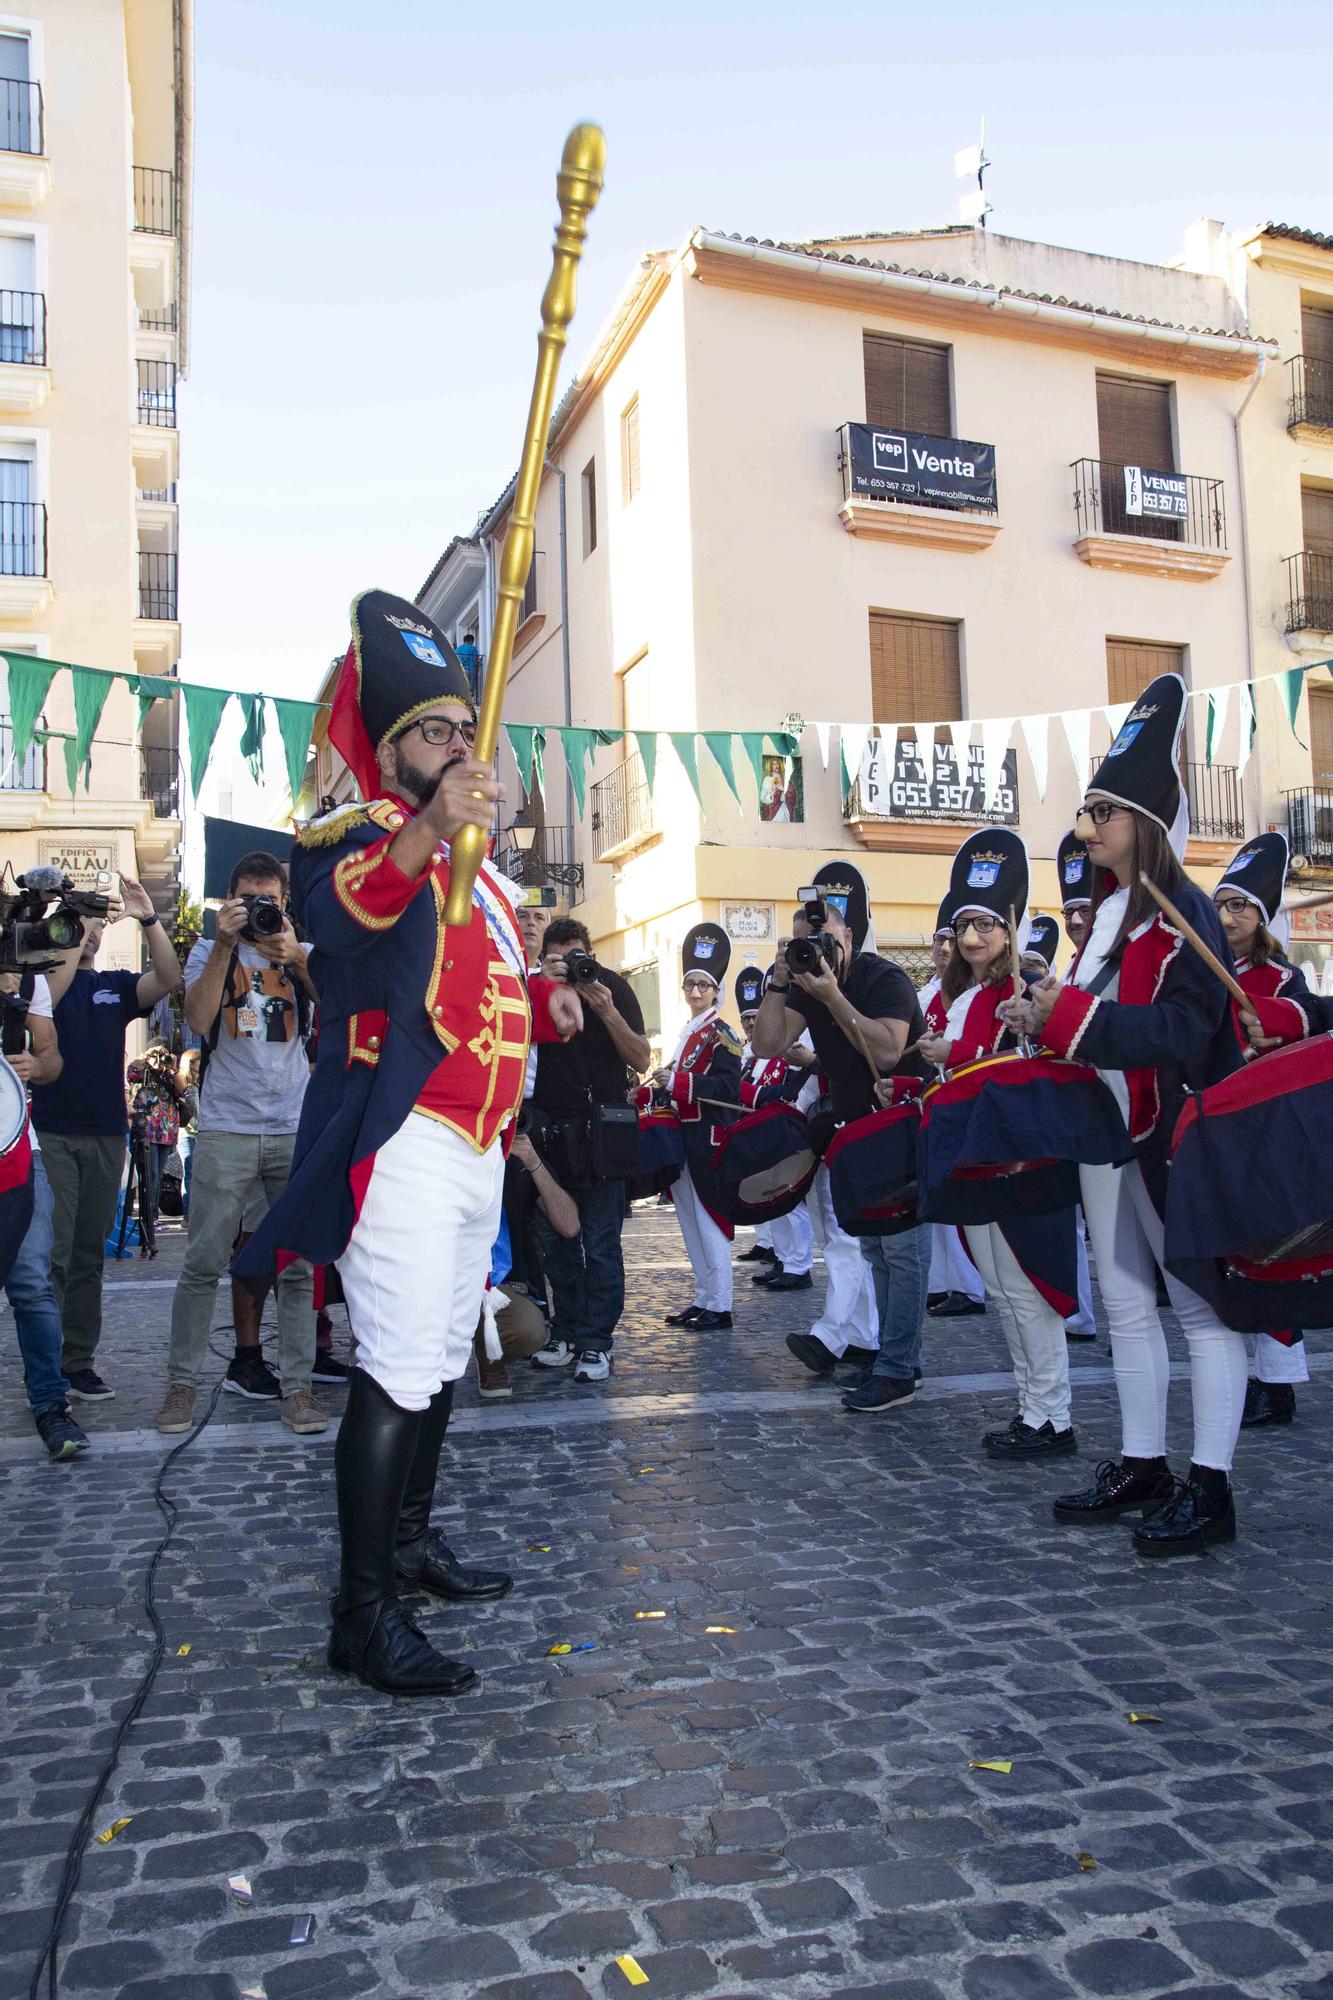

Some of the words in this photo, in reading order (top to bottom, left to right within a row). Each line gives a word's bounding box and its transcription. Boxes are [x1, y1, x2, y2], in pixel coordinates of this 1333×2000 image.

[877, 441, 902, 457] vep
[912, 448, 975, 478] Venta
[856, 476, 869, 486] Tel.
[870, 478, 885, 488] 653
[886, 480, 899, 490] 357
[901, 482, 916, 493] 733
[1143, 476, 1186, 494] VENDE
[923, 487, 993, 504] vepinmobiliaria.com
[1143, 493, 1158, 508] 653
[1159, 494, 1173, 511] 357
[1174, 497, 1188, 512] 733
[934, 743, 986, 764] VEND
[892, 781, 932, 807] 653
[937, 784, 975, 810] 357
[980, 787, 1014, 814] 33
[60, 849, 97, 857] EDIFICI
[51, 856, 108, 870] PALAU
